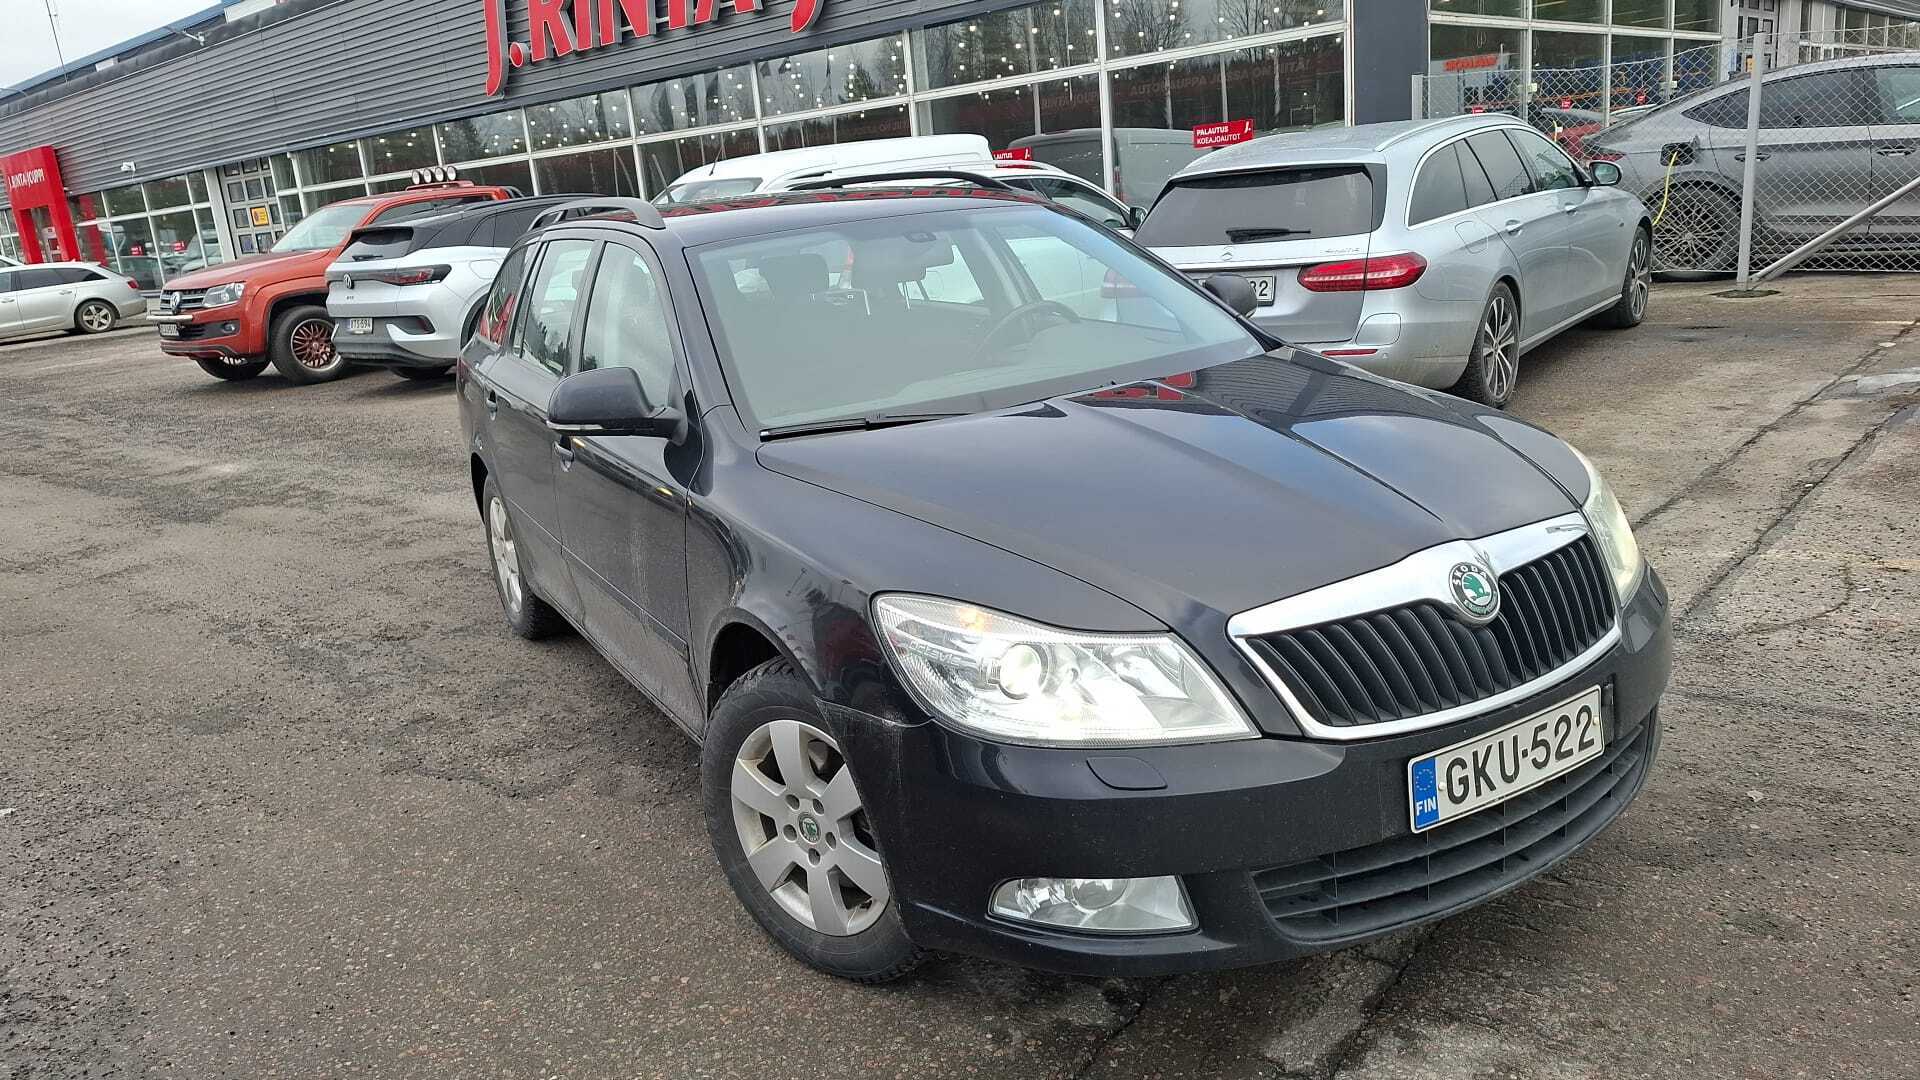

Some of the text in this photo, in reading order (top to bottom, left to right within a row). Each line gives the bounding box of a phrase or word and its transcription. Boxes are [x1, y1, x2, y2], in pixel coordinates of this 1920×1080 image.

[1196, 126, 1229, 136] PALAUTUS
[1197, 133, 1241, 145] KOEAJOAUTOT
[1446, 704, 1595, 805] GKU-522
[1415, 796, 1437, 816] FIN
